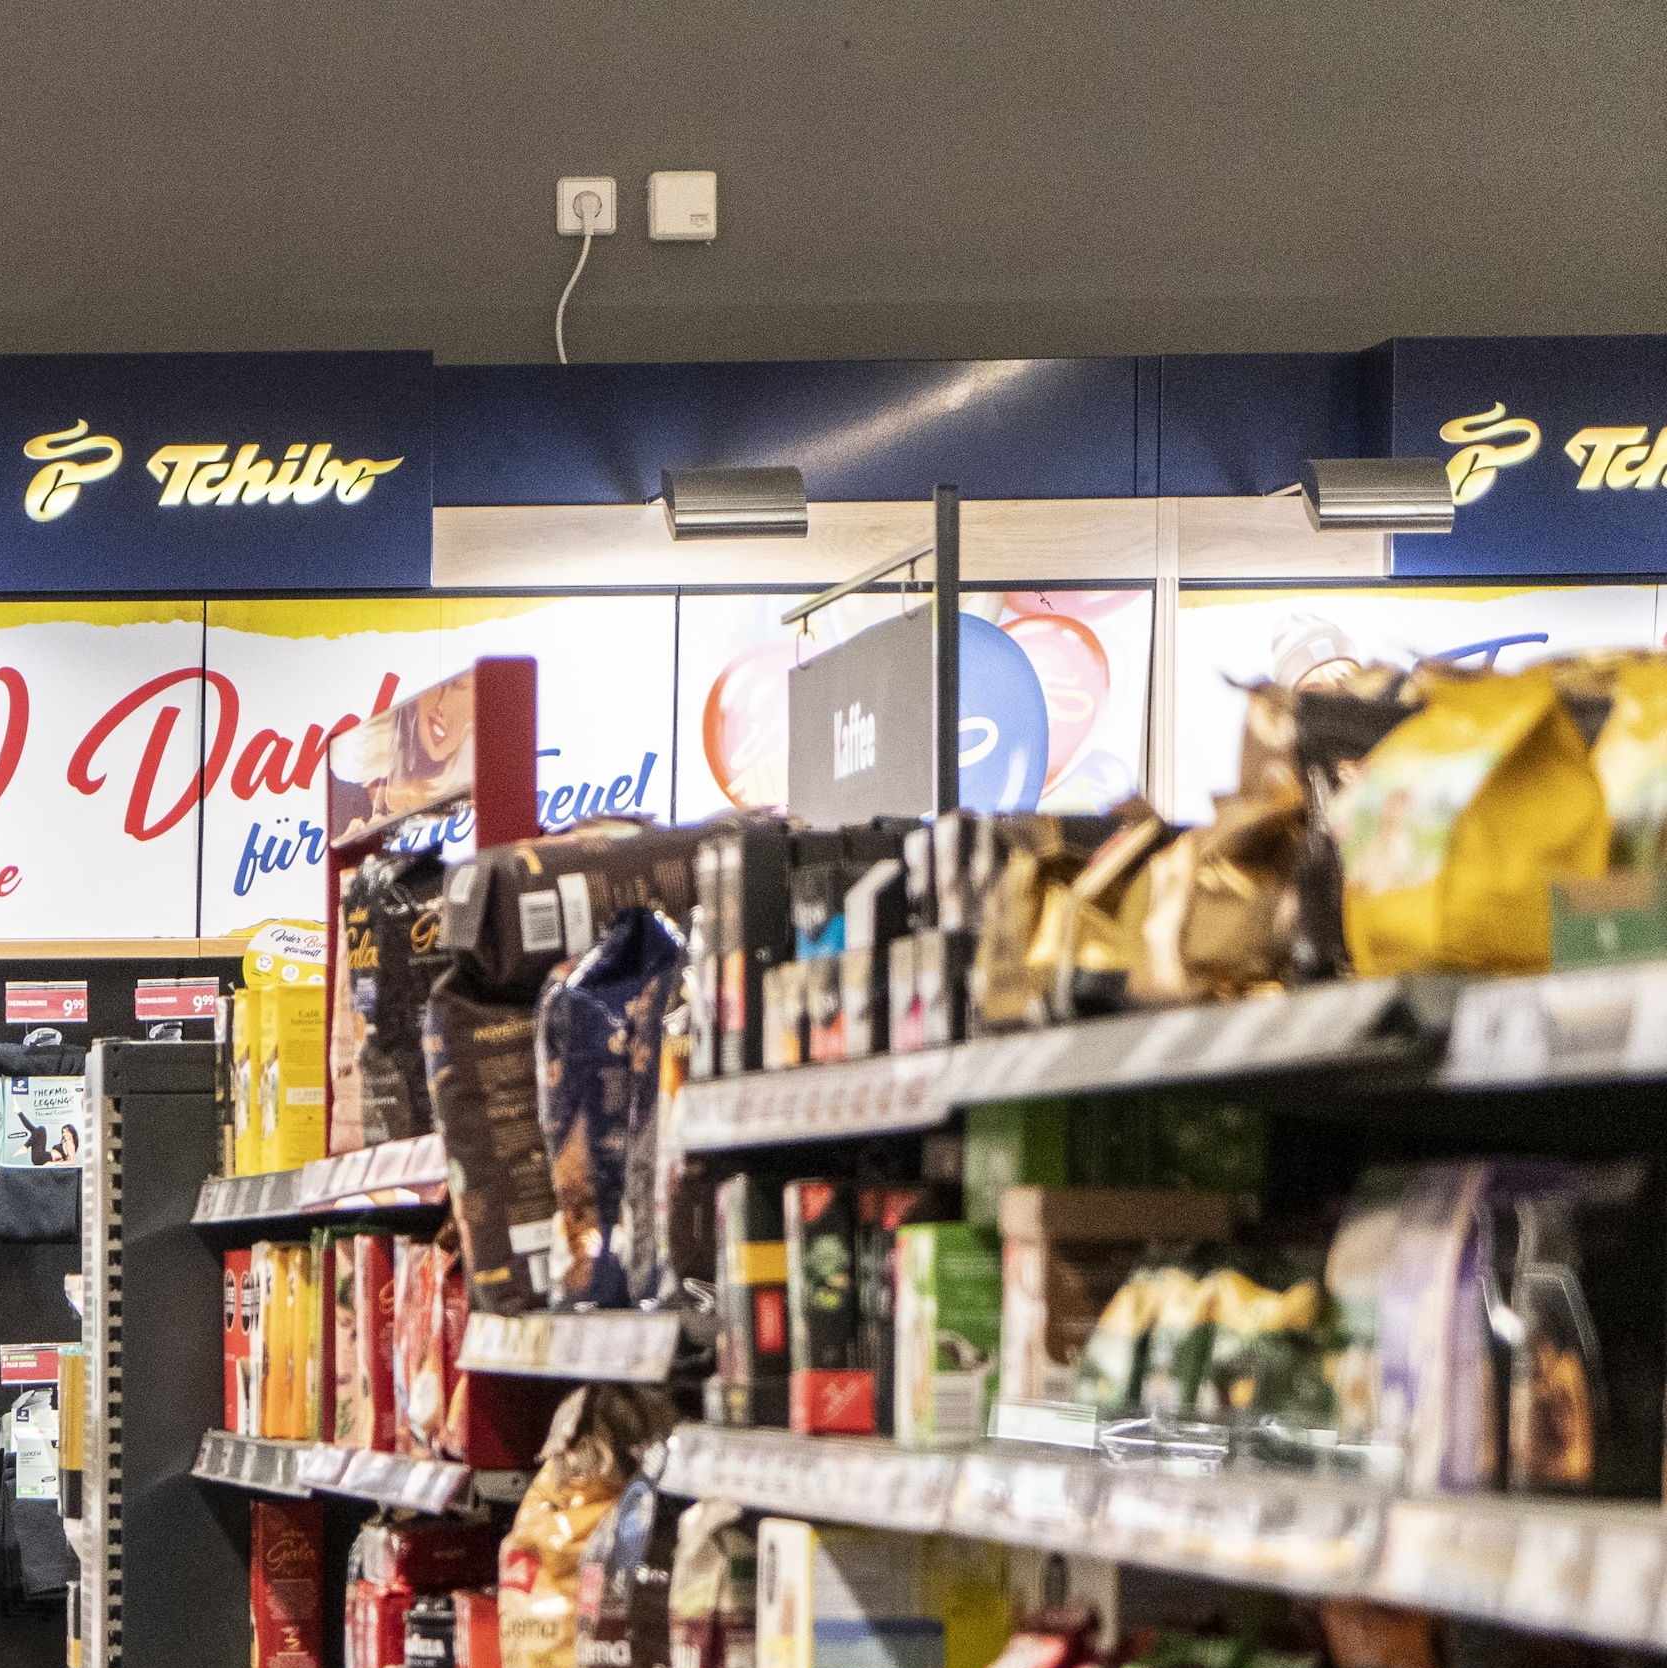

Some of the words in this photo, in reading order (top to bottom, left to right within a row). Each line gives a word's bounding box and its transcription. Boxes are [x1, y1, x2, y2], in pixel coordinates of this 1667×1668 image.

[147, 442, 404, 506] Tchibo
[833, 703, 877, 782] Kaffee
[231, 811, 324, 898] für
[269, 927, 304, 951] Jeder
[282, 942, 322, 960] gewinnt!
[32, 1087, 71, 1098] THERMO-
[33, 1096, 75, 1108] LEGGINGS
